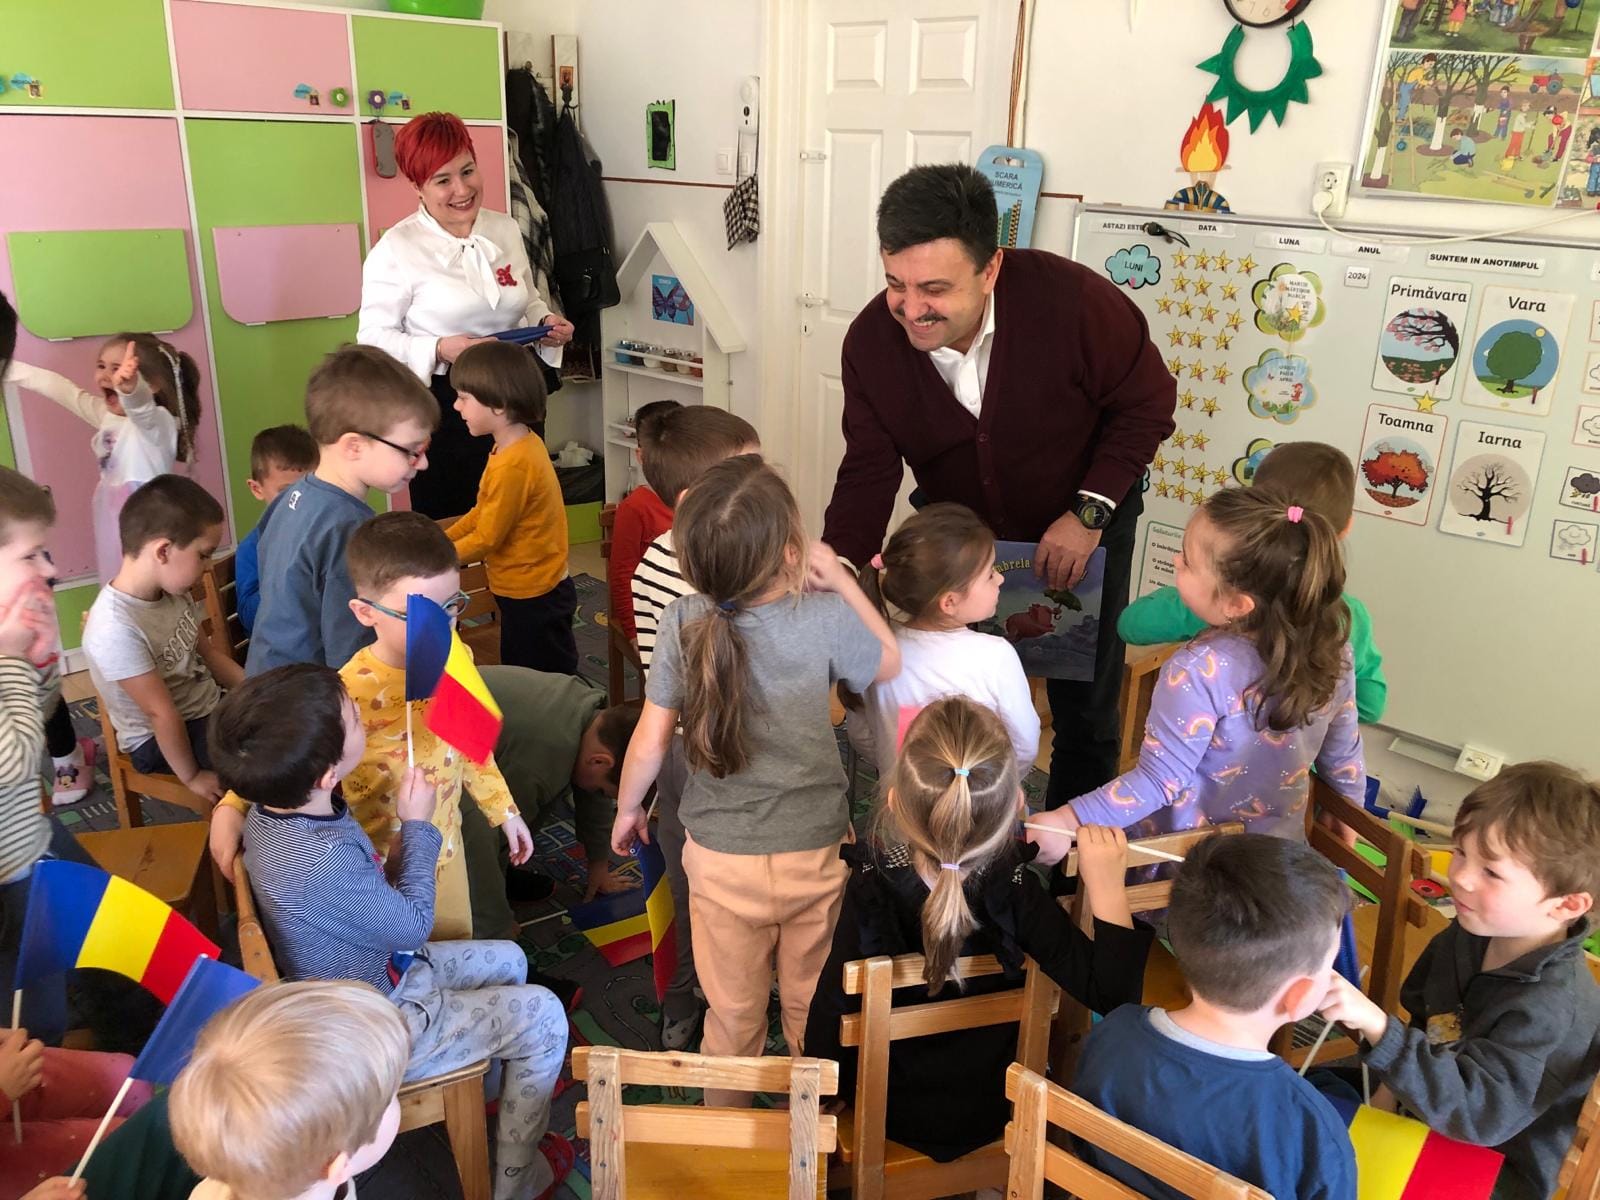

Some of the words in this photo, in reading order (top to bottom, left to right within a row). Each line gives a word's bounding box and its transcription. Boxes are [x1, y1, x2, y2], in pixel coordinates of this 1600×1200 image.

[994, 171, 1018, 181] SCARA
[991, 180, 1023, 192] UMERICĂ
[1102, 222, 1126, 230] ASTAZI
[1198, 224, 1217, 232] DATA
[1279, 237, 1300, 247] LUNA
[1358, 245, 1381, 256] ANUL
[1124, 261, 1144, 272] LUNI
[1430, 253, 1468, 264] SUNTEM
[1470, 257, 1481, 265] IN
[1482, 258, 1540, 270] ANOTIMPUL
[1347, 271, 1367, 280] 2024
[1391, 284, 1467, 303] Primăvara
[1508, 296, 1546, 312] Vara
[1377, 412, 1434, 433] Toamna
[1477, 431, 1522, 449] Iarna
[993, 557, 1031, 574] mbrela
